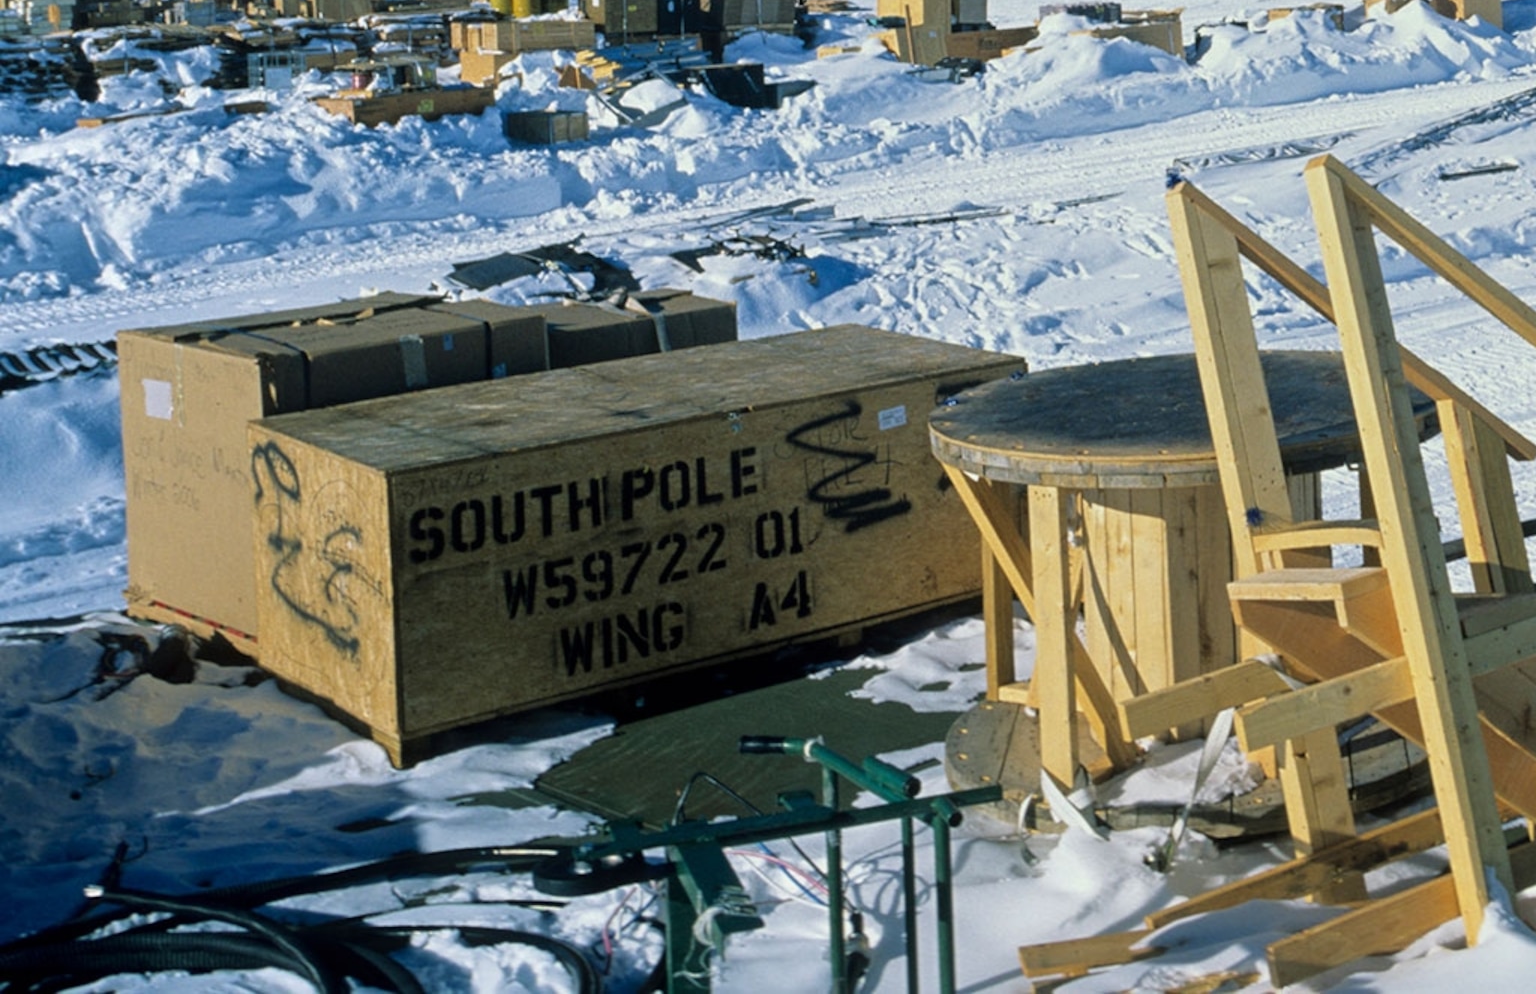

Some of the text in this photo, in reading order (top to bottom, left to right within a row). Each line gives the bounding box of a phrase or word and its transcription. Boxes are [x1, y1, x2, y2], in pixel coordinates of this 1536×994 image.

[409, 476, 609, 564] SOUTH
[621, 446, 758, 522] POLE
[503, 522, 727, 620] W59722
[560, 570, 812, 677] WING A4
